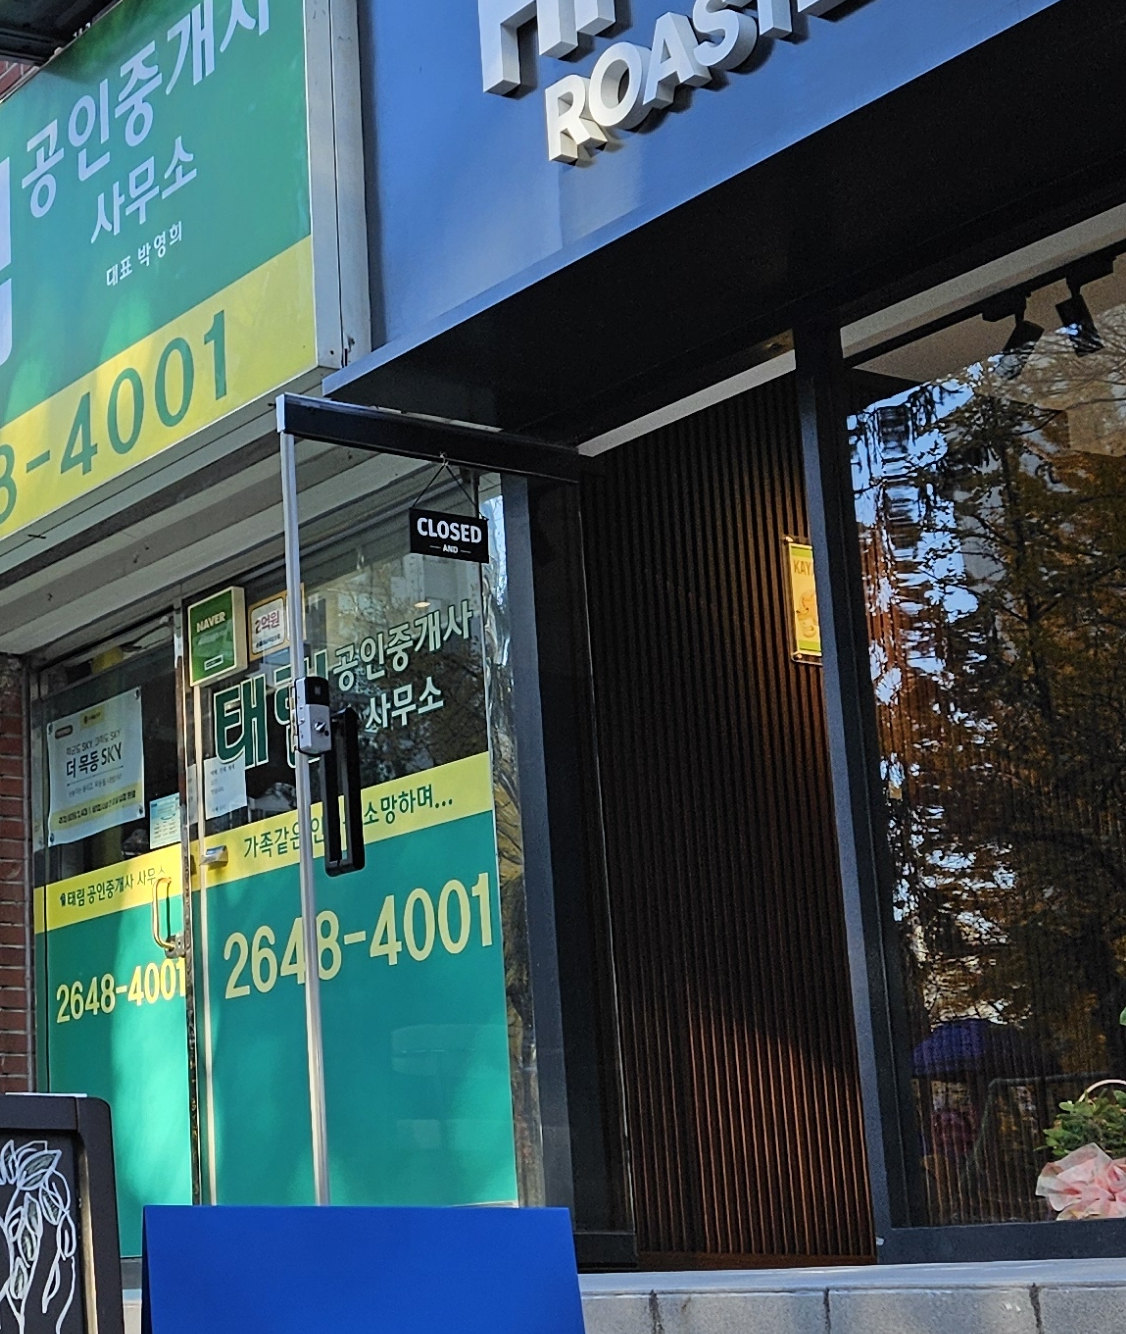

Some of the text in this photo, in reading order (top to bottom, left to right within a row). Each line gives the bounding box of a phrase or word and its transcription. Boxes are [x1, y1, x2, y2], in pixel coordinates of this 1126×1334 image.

[90, 138, 197, 244] 사무소
[105, 222, 183, 288] 대표 박영희
[417, 517, 482, 544] CLOSED
[442, 544, 459, 554] AND
[794, 559, 814, 576] KAY
[196, 611, 226, 633] NAVER
[255, 610, 280, 634] 2억원
[333, 599, 475, 694] 공인중개사
[365, 676, 446, 732] 사무소
[78, 750, 100, 775] 목동
[101, 742, 123, 766] SKY
[67, 889, 86, 907] 태림
[87, 873, 135, 905] 공인중개사
[223, 872, 493, 1000] 2648-4001
[56, 956, 186, 1025] 2648-4001
